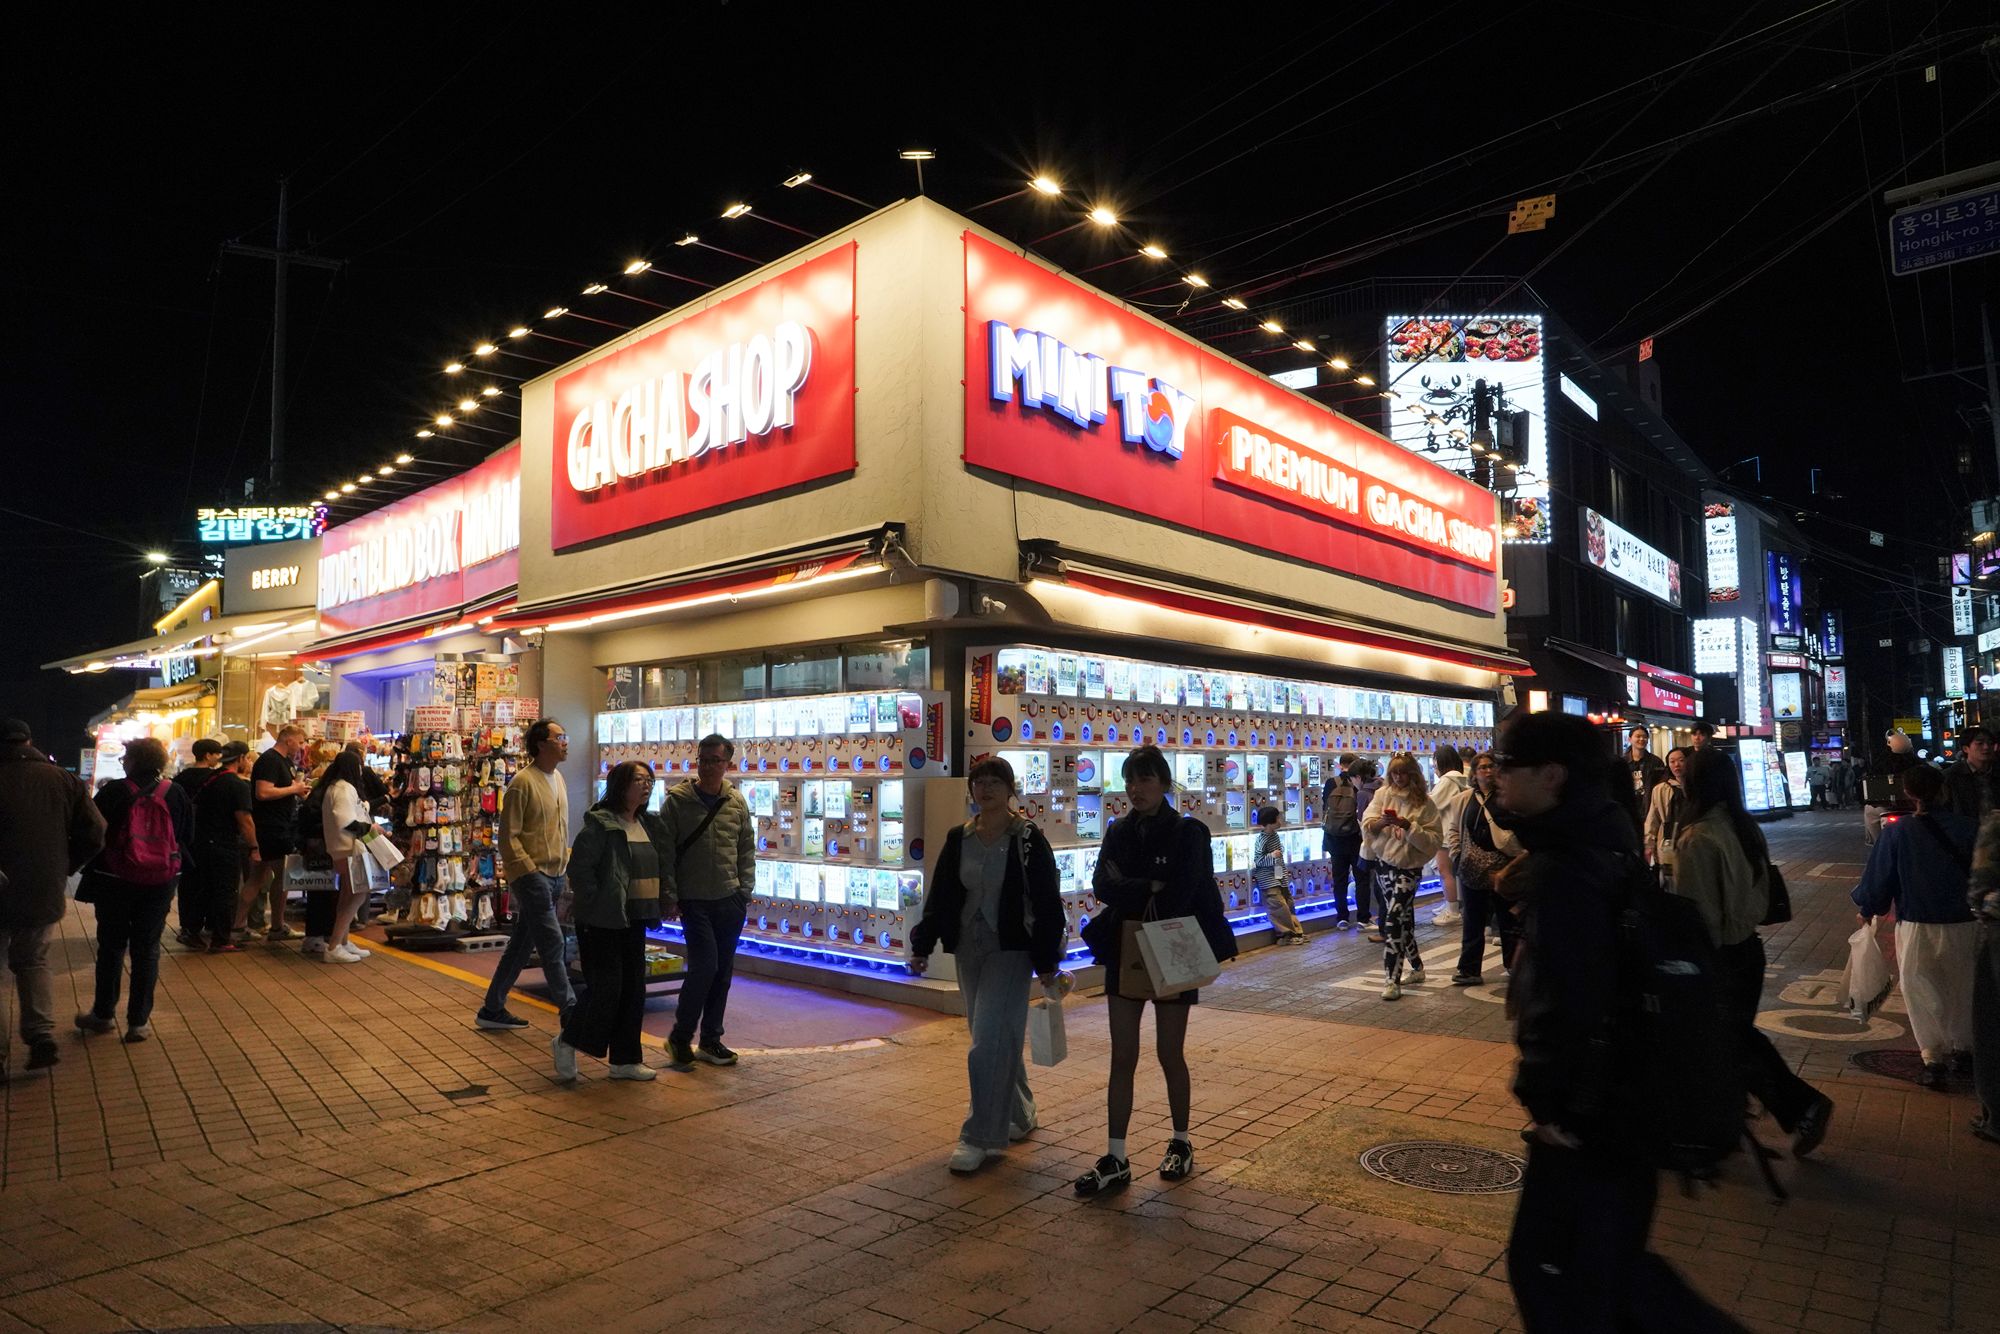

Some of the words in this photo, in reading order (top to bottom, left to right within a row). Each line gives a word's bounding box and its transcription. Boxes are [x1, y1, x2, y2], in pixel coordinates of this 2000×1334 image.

[1899, 194, 2000, 236] 홍익로3길
[1899, 226, 1979, 252] Hongik-ro
[567, 370, 689, 492] GACHA
[688, 321, 812, 457] SHOP
[988, 320, 1107, 430] MINI
[1107, 365, 1196, 460] TOY
[1231, 425, 1358, 514] PREMIUM
[1366, 485, 1448, 547] GACHA
[1449, 518, 1493, 562] SHOP
[252, 566, 299, 590] BERRY
[318, 543, 367, 611] HIDDEN
[368, 526, 415, 597] BLIND
[414, 510, 462, 582] BOX
[970, 688, 980, 720] MINI
[927, 731, 936, 758] MINI
